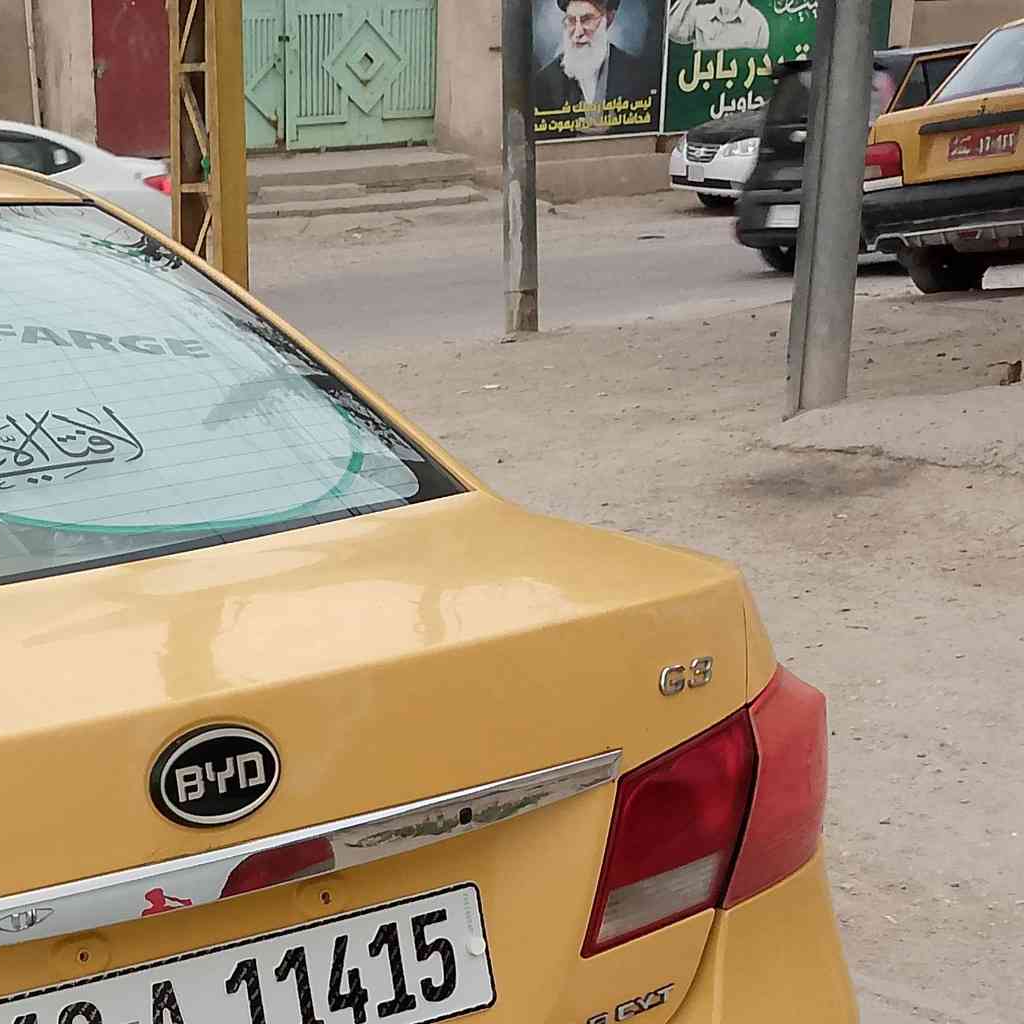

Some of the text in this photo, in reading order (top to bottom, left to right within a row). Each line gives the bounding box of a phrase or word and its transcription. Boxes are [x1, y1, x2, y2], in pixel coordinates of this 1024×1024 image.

[678, 48, 738, 92] بابل
[629, 95, 653, 111] ليس
[710, 90, 772, 119] حاويل
[658, 656, 714, 697] G3
[175, 751, 266, 803] BYD
